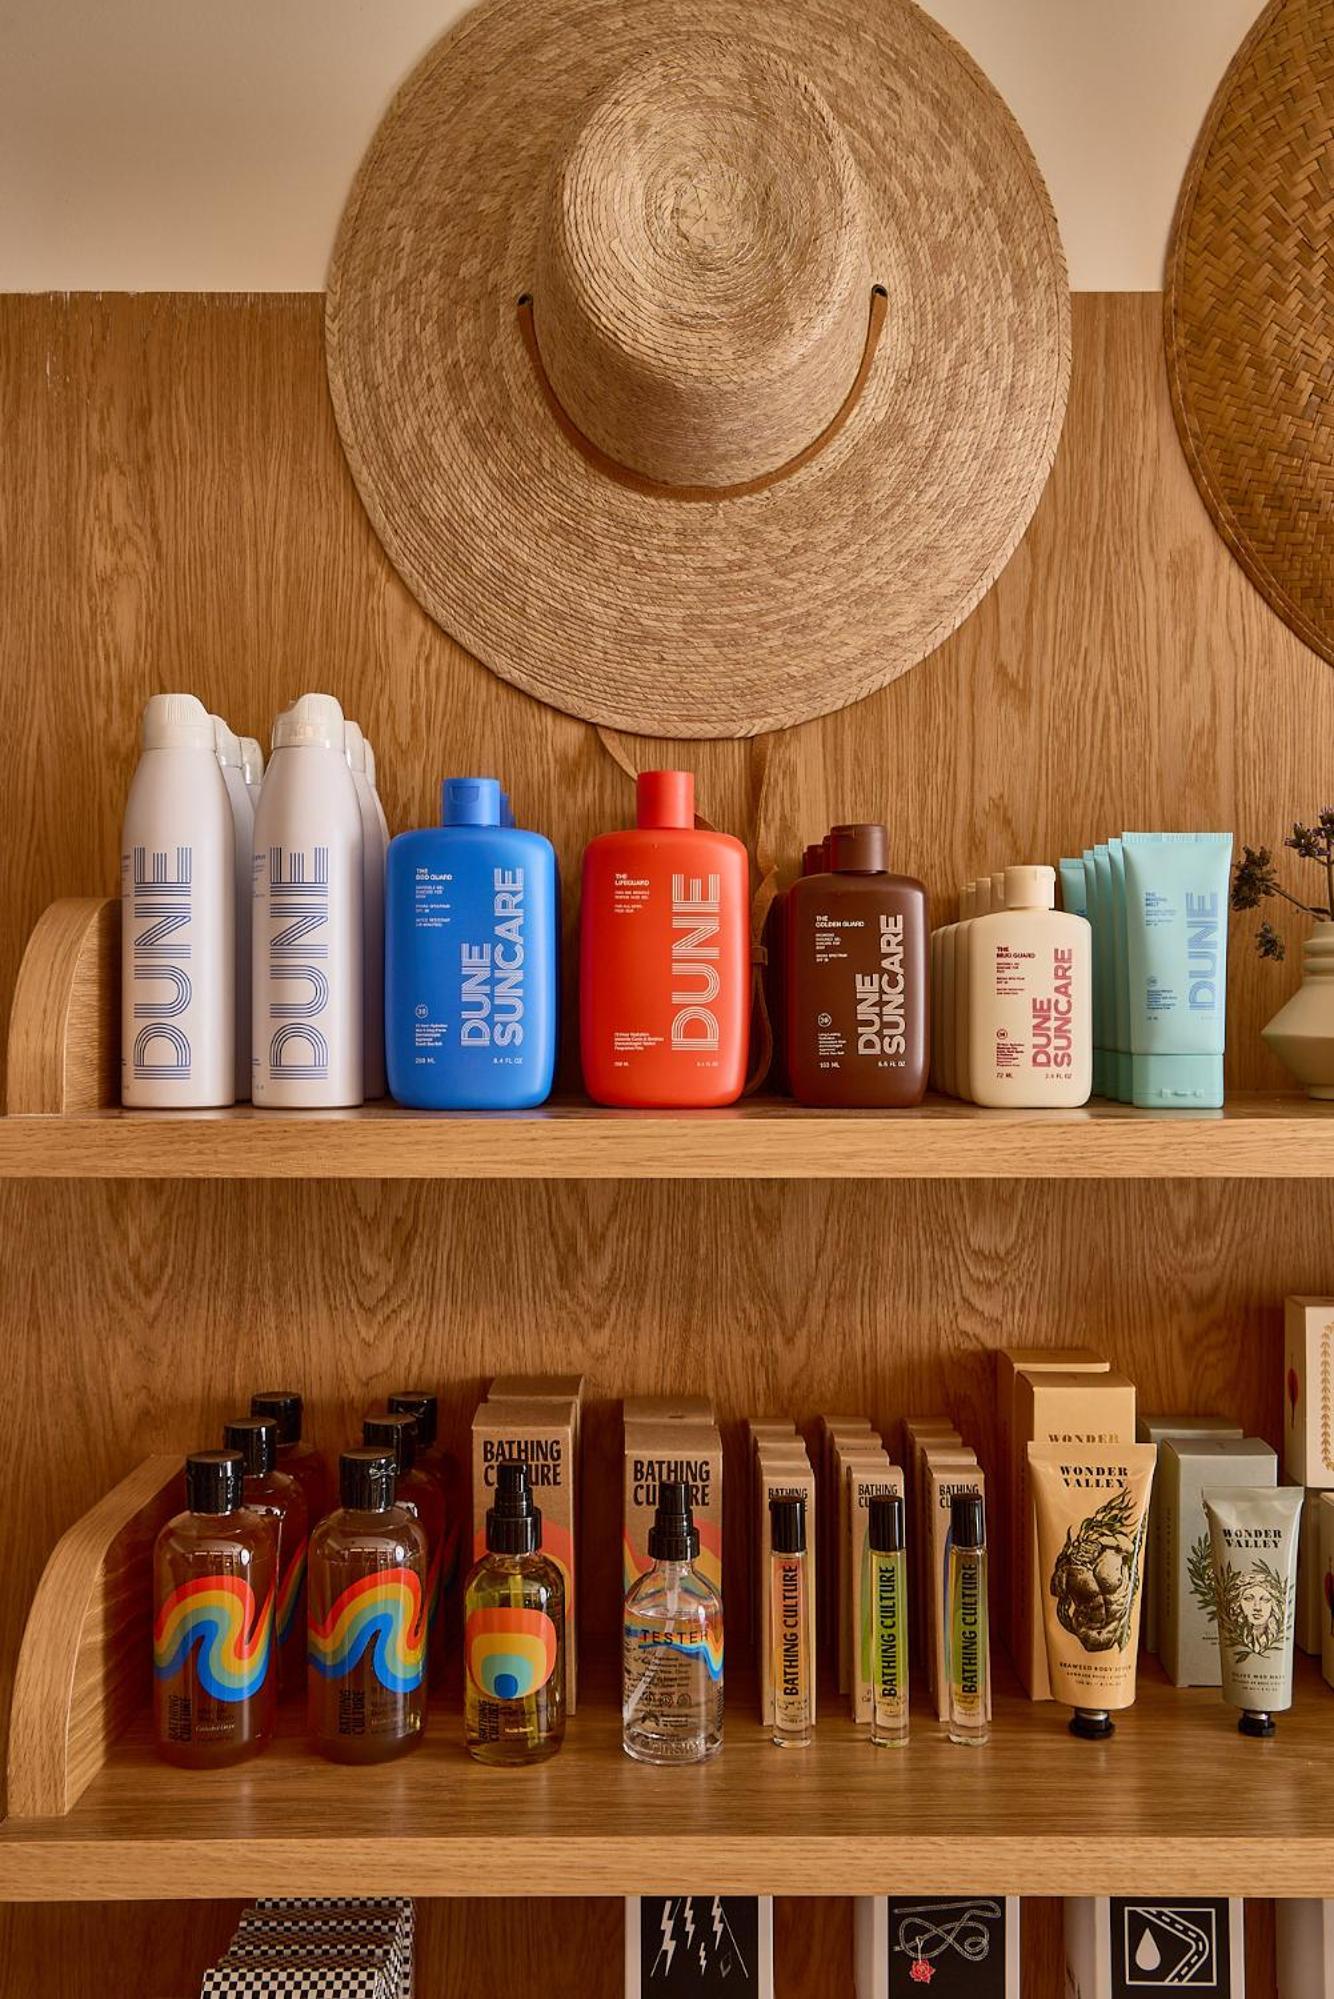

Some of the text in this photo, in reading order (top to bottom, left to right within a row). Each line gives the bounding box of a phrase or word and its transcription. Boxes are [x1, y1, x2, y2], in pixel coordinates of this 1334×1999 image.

[134, 847, 191, 1080] DUNE
[270, 847, 328, 1080] DUNE
[494, 867, 525, 1046] SUNCARE
[672, 874, 720, 1051] DUNE
[1186, 892, 1219, 1011] DUNE
[461, 943, 492, 1046] DUNE
[880, 914, 906, 1055] SUNCARE
[855, 973, 882, 1056] DUNE
[1054, 948, 1073, 1068] SUNCARE
[1032, 997, 1051, 1068] DUNE
[483, 1440, 562, 1462] BATHING
[1048, 1433, 1120, 1444] WONDER
[483, 1464, 562, 1486] CURE
[633, 1460, 710, 1482] BATHING
[858, 1484, 898, 1495] BATHING
[940, 1484, 979, 1496] BATHING
[1060, 1466, 1128, 1476] WONDER
[1063, 1478, 1125, 1488] VALLEY
[633, 1484, 710, 1506] CURE
[1222, 1529, 1282, 1538] WONDER
[1225, 1539, 1280, 1548] VALLEY
[783, 1564, 798, 1629] CULTURE
[641, 1629, 708, 1645] TESTER
[879, 1565, 897, 1697] BATHING CULTURE
[961, 1563, 977, 1694] BATHING CULTURE
[783, 1633, 799, 1696] BATHING
[168, 1694, 179, 1741] BATHING
[180, 1697, 192, 1742] CULTURE
[339, 1689, 351, 1735] BATHING
[352, 1690, 366, 1735] CULTURE
[479, 1700, 491, 1742] BATHING
[489, 1704, 500, 1742] CULTURE
